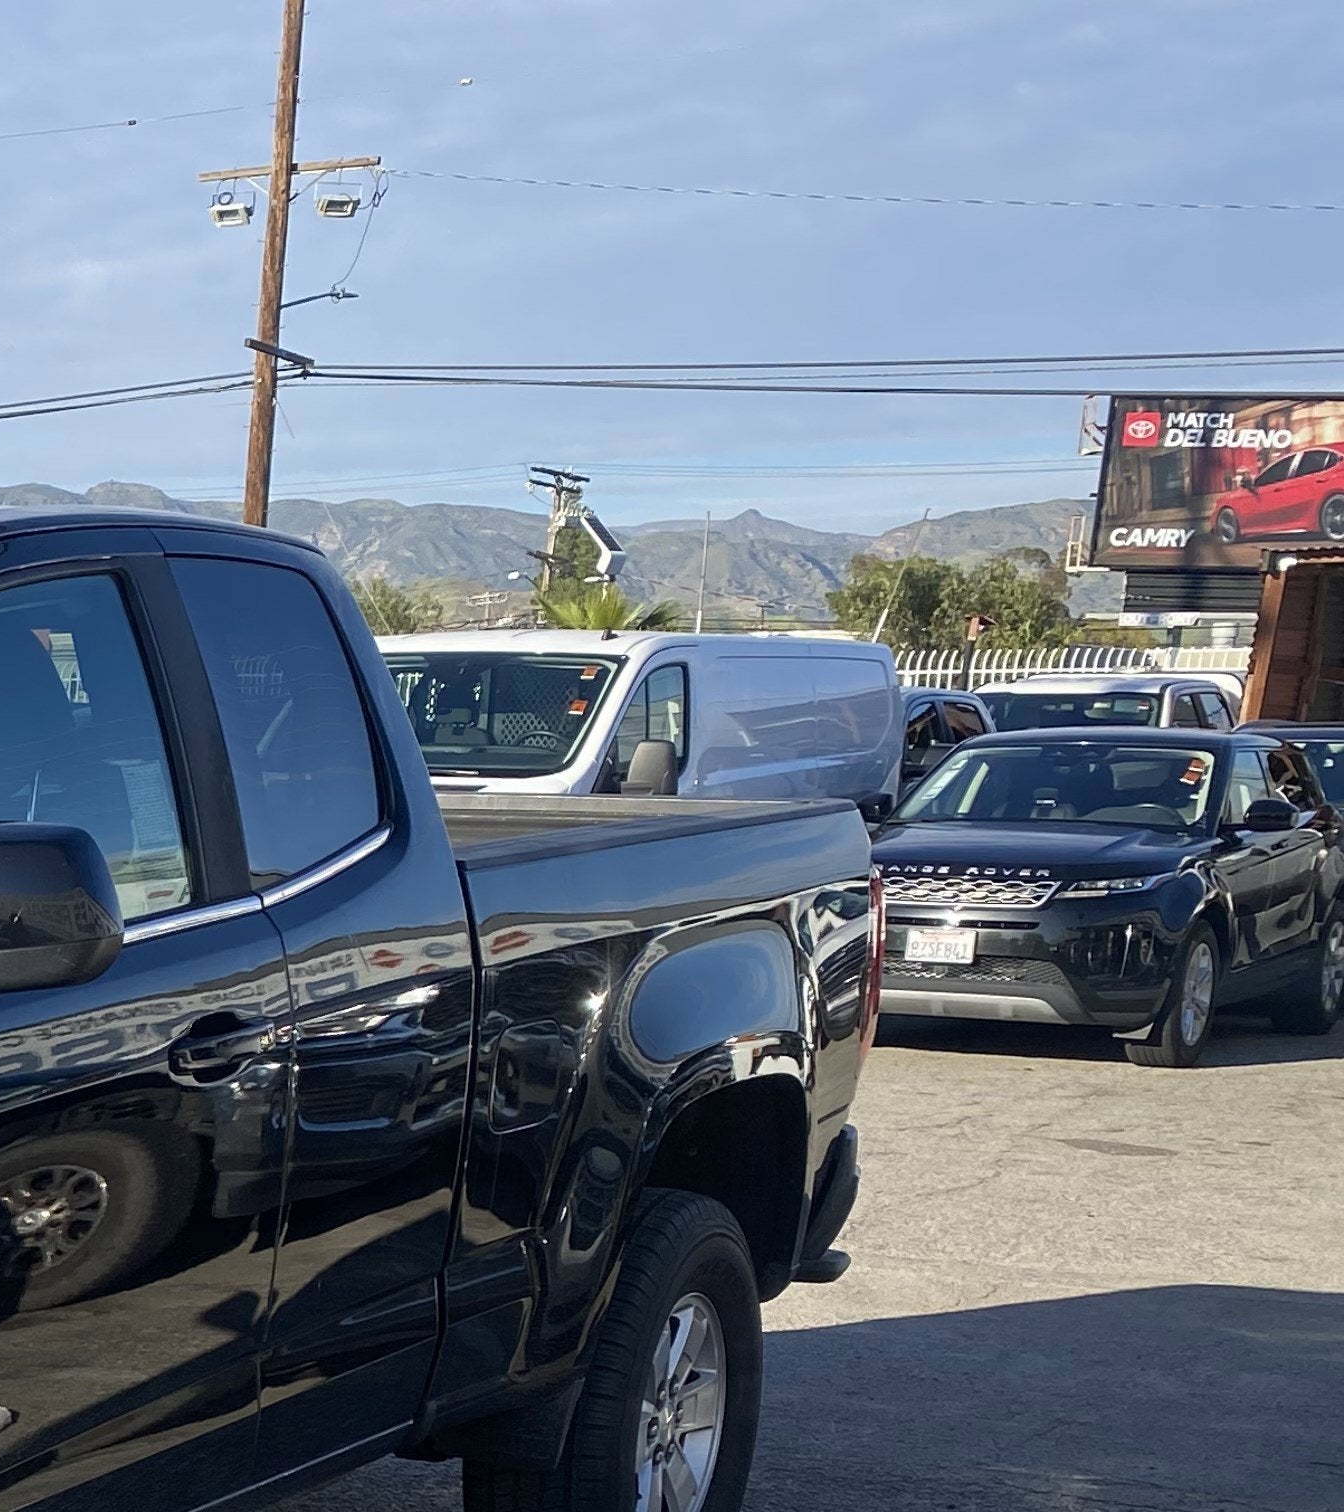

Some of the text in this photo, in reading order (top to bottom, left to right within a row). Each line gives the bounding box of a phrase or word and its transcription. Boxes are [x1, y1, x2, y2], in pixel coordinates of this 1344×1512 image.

[1166, 411, 1235, 429] MATCH
[1163, 428, 1292, 449] DEL BUENO
[1109, 526, 1196, 548] CAMRY
[965, 865, 1051, 878] ROVER
